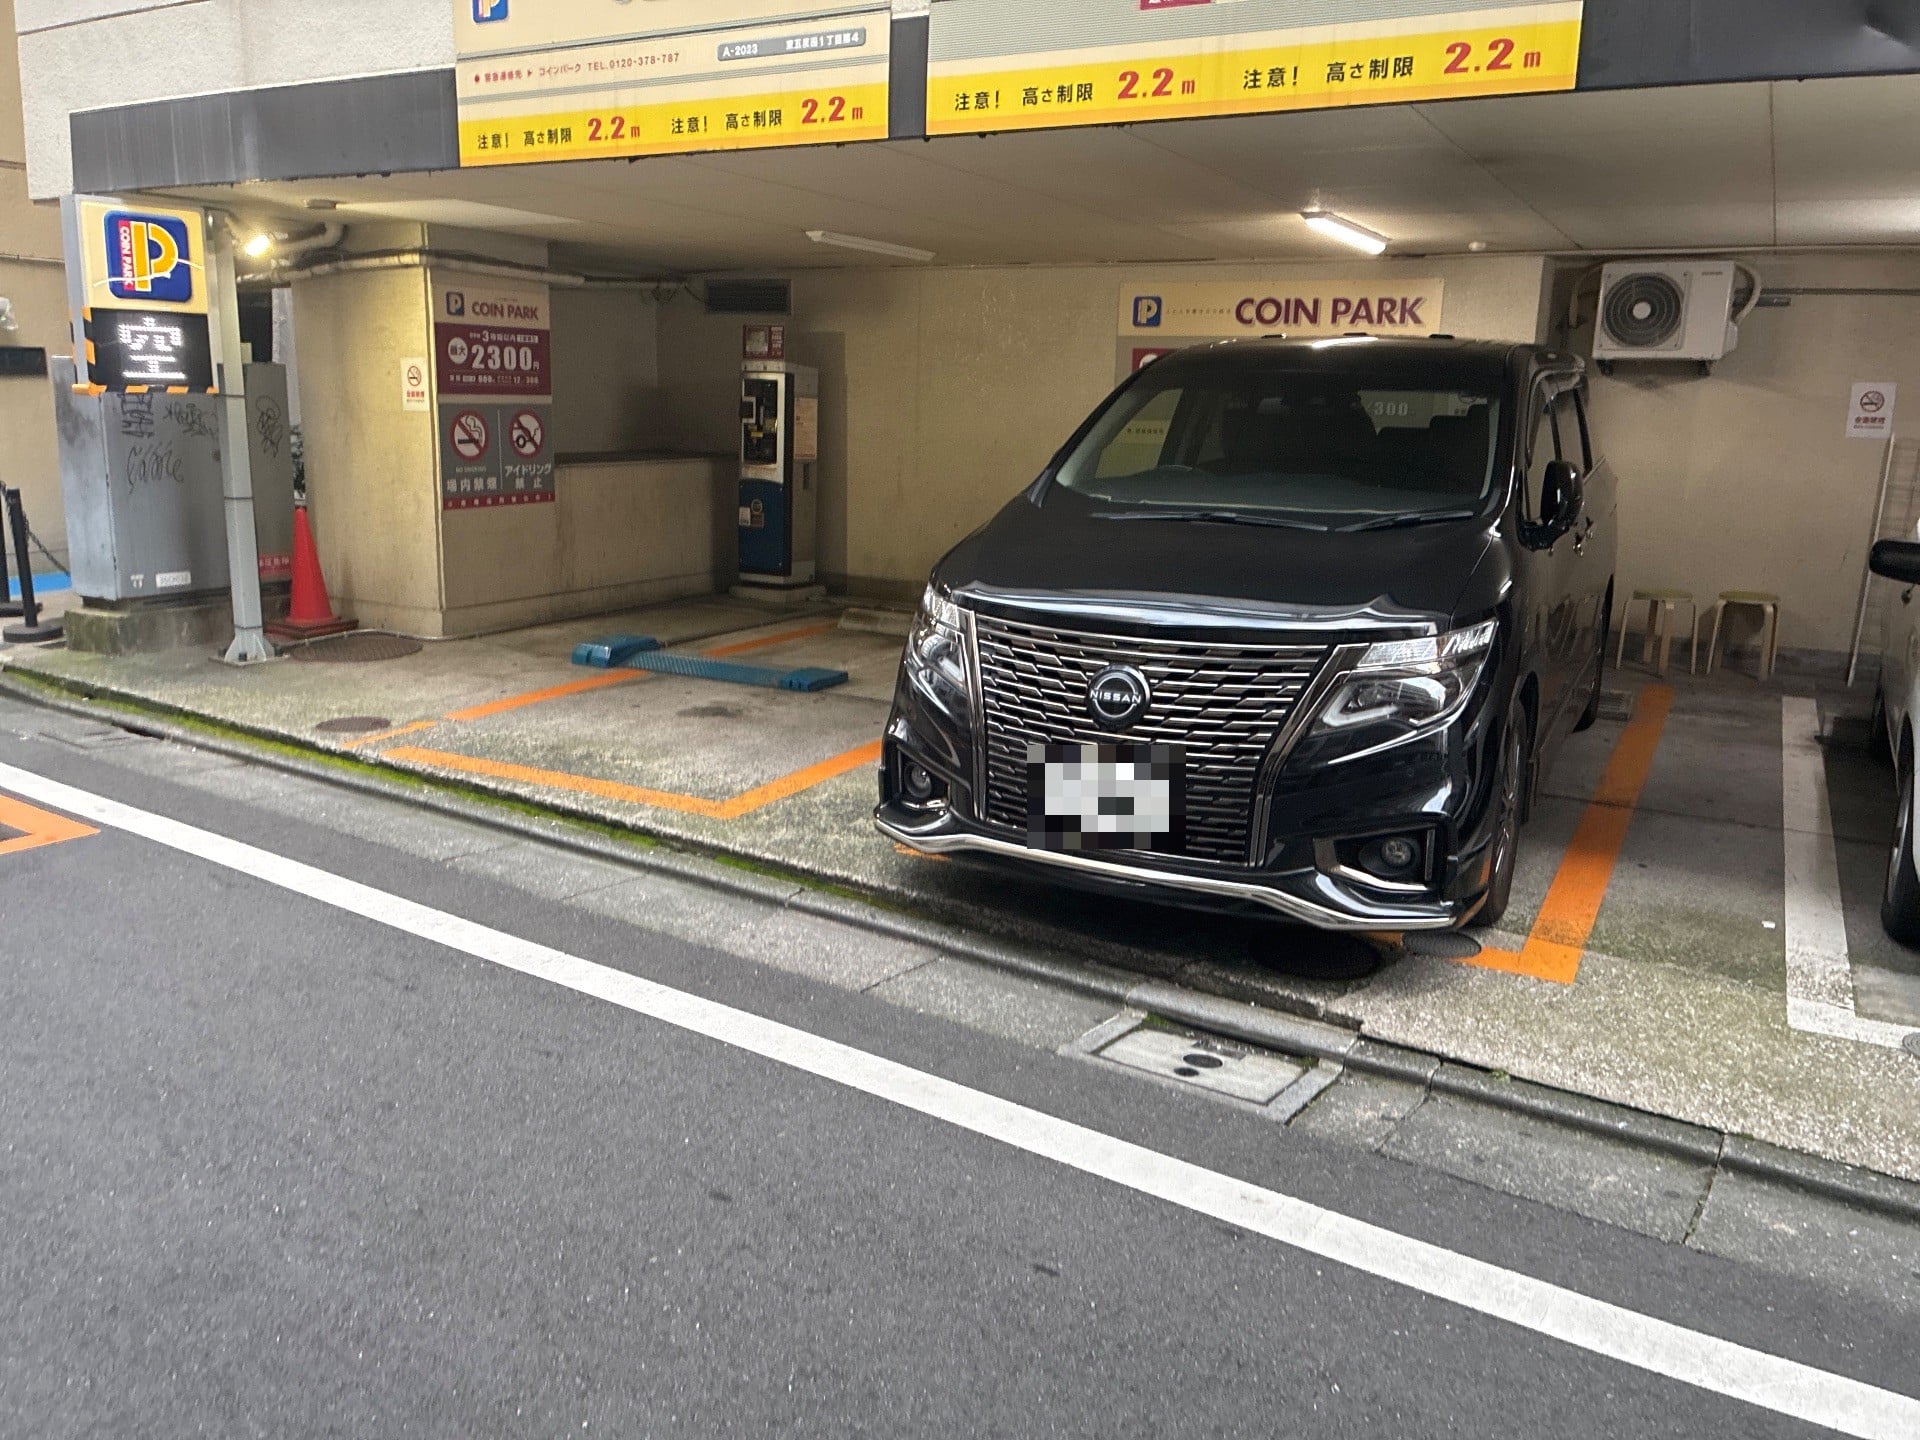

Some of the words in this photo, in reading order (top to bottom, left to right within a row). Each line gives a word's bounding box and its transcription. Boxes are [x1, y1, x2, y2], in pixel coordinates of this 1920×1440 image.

[723, 43, 758, 57] A-2023
[539, 63, 581, 76] コインパーク
[1243, 66, 1299, 90] 注意!
[1326, 56, 1414, 84] 高さ制限
[954, 90, 1000, 112] 注意!
[1022, 83, 1093, 107] 高さ制限
[671, 115, 708, 135] 注意!
[725, 109, 782, 131] 高さ制限
[477, 132, 509, 150] 注意!
[523, 127, 573, 147] 高さ制限
[118, 225, 132, 256] COIN
[471, 301, 504, 318] COIN
[507, 304, 539, 320] PARK
[1235, 296, 1320, 325] COIN
[1330, 296, 1424, 325] PARK
[504, 463, 552, 477] アイドリング
[1089, 689, 1141, 704] NISSAN
